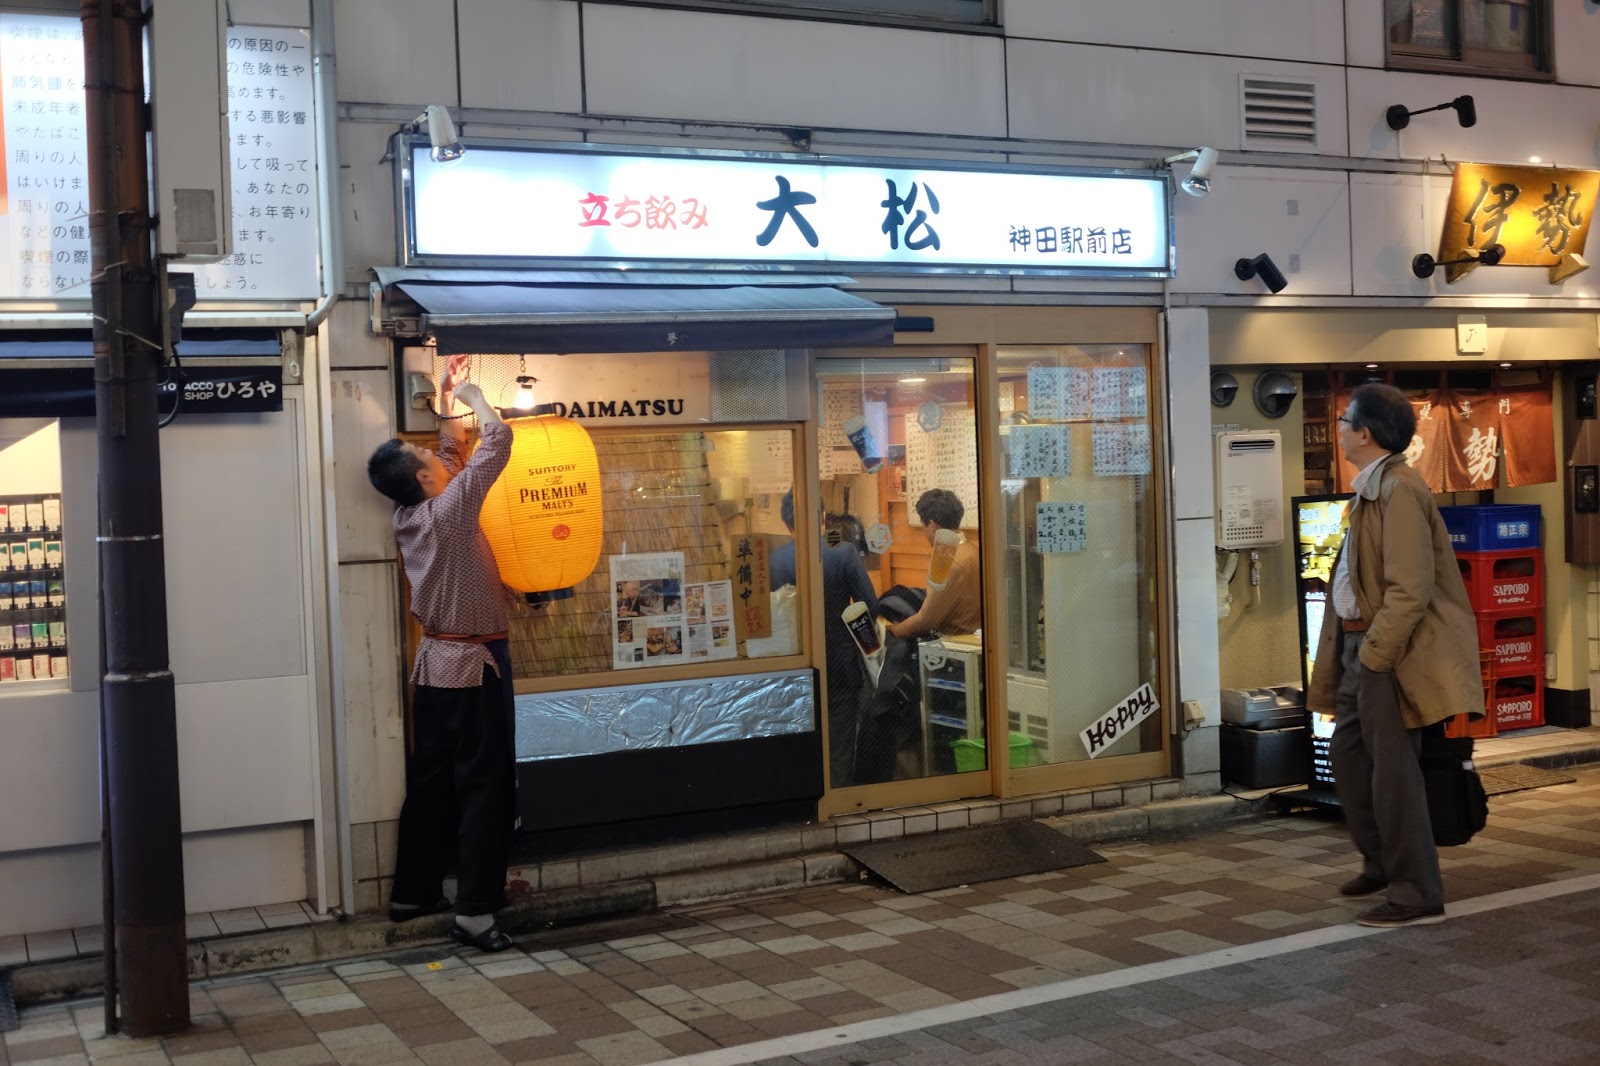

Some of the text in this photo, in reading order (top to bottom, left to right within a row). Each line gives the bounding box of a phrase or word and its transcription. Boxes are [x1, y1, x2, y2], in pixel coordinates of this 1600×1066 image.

[16, 149, 82, 164] 周りの人
[18, 175, 82, 189] はいけま
[18, 199, 310, 219] 周りの人 、お年寄り
[578, 175, 1132, 254] 立ち飲み 大松 神田駅前店
[20, 225, 91, 240] などの健
[20, 250, 88, 264] 喫煙の際
[184, 391, 214, 401] SHOP
[216, 380, 277, 399] ひろや
[553, 399, 684, 418] DAIMATSU
[528, 463, 577, 477] SUNTORY
[519, 481, 588, 504] PREMIUM
[542, 499, 574, 511] MALTS
[736, 538, 754, 608] 準備中
[1493, 583, 1530, 597] SAPPORO
[1495, 642, 1532, 656] SAPPORO
[1086, 685, 1155, 754] Hoppy
